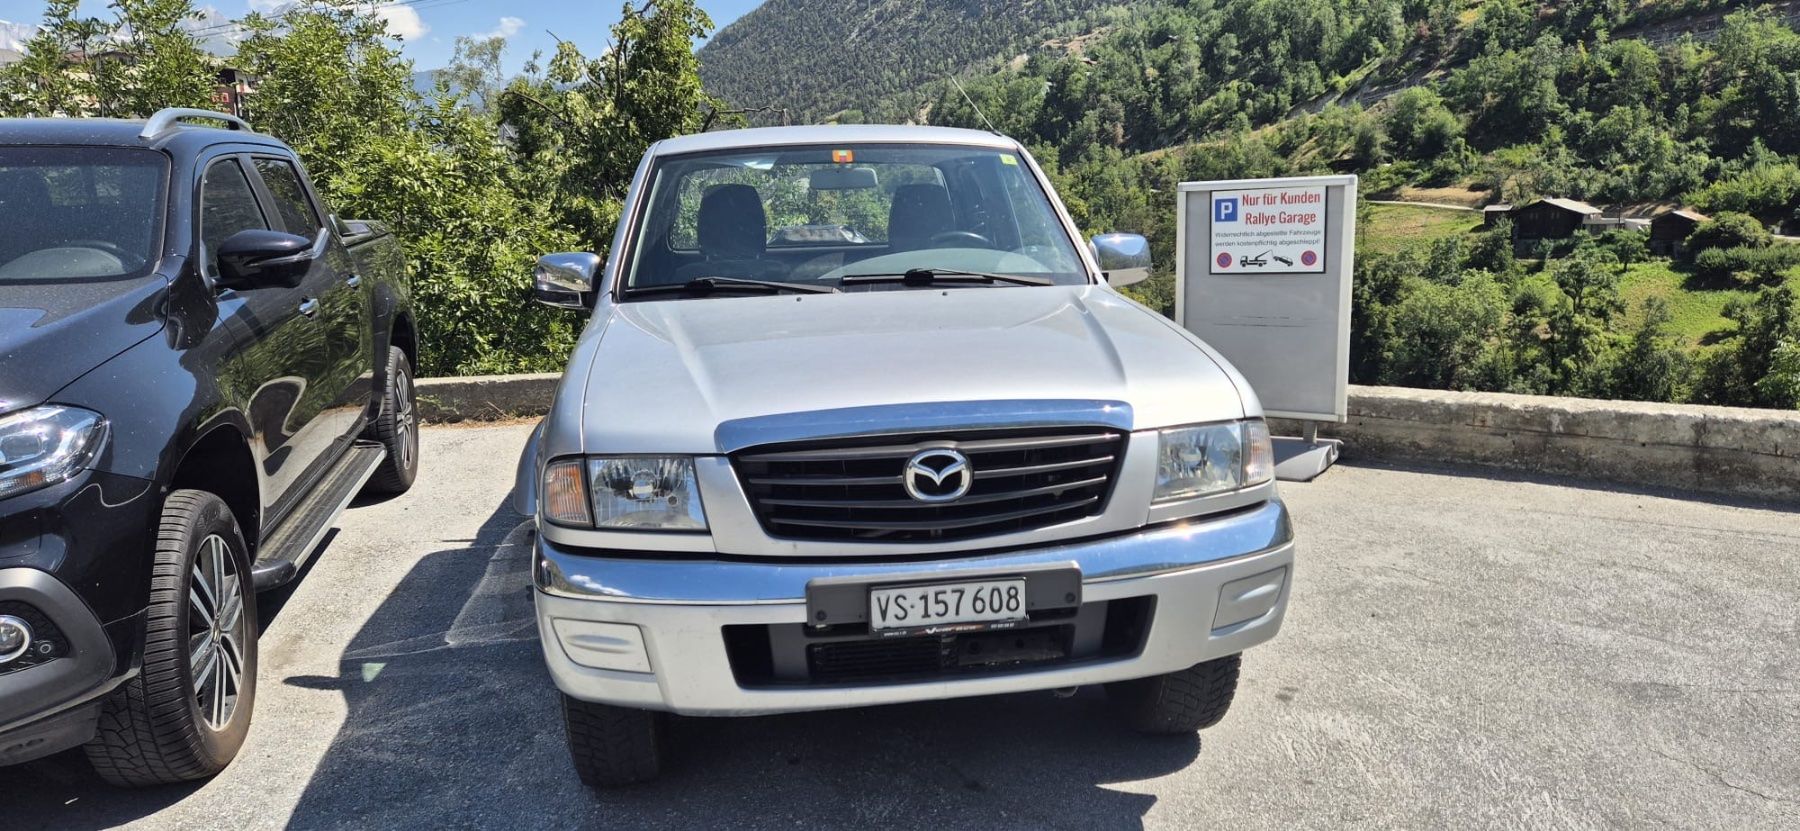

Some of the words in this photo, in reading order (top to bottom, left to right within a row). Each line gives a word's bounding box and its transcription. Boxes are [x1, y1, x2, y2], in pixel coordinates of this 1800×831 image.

[1242, 194, 1260, 206] Nur
[1263, 193, 1277, 205] für
[1280, 191, 1321, 205] Kunden
[1221, 202, 1232, 219] P
[1245, 212, 1276, 226] Rallye
[1279, 211, 1316, 226] Garage
